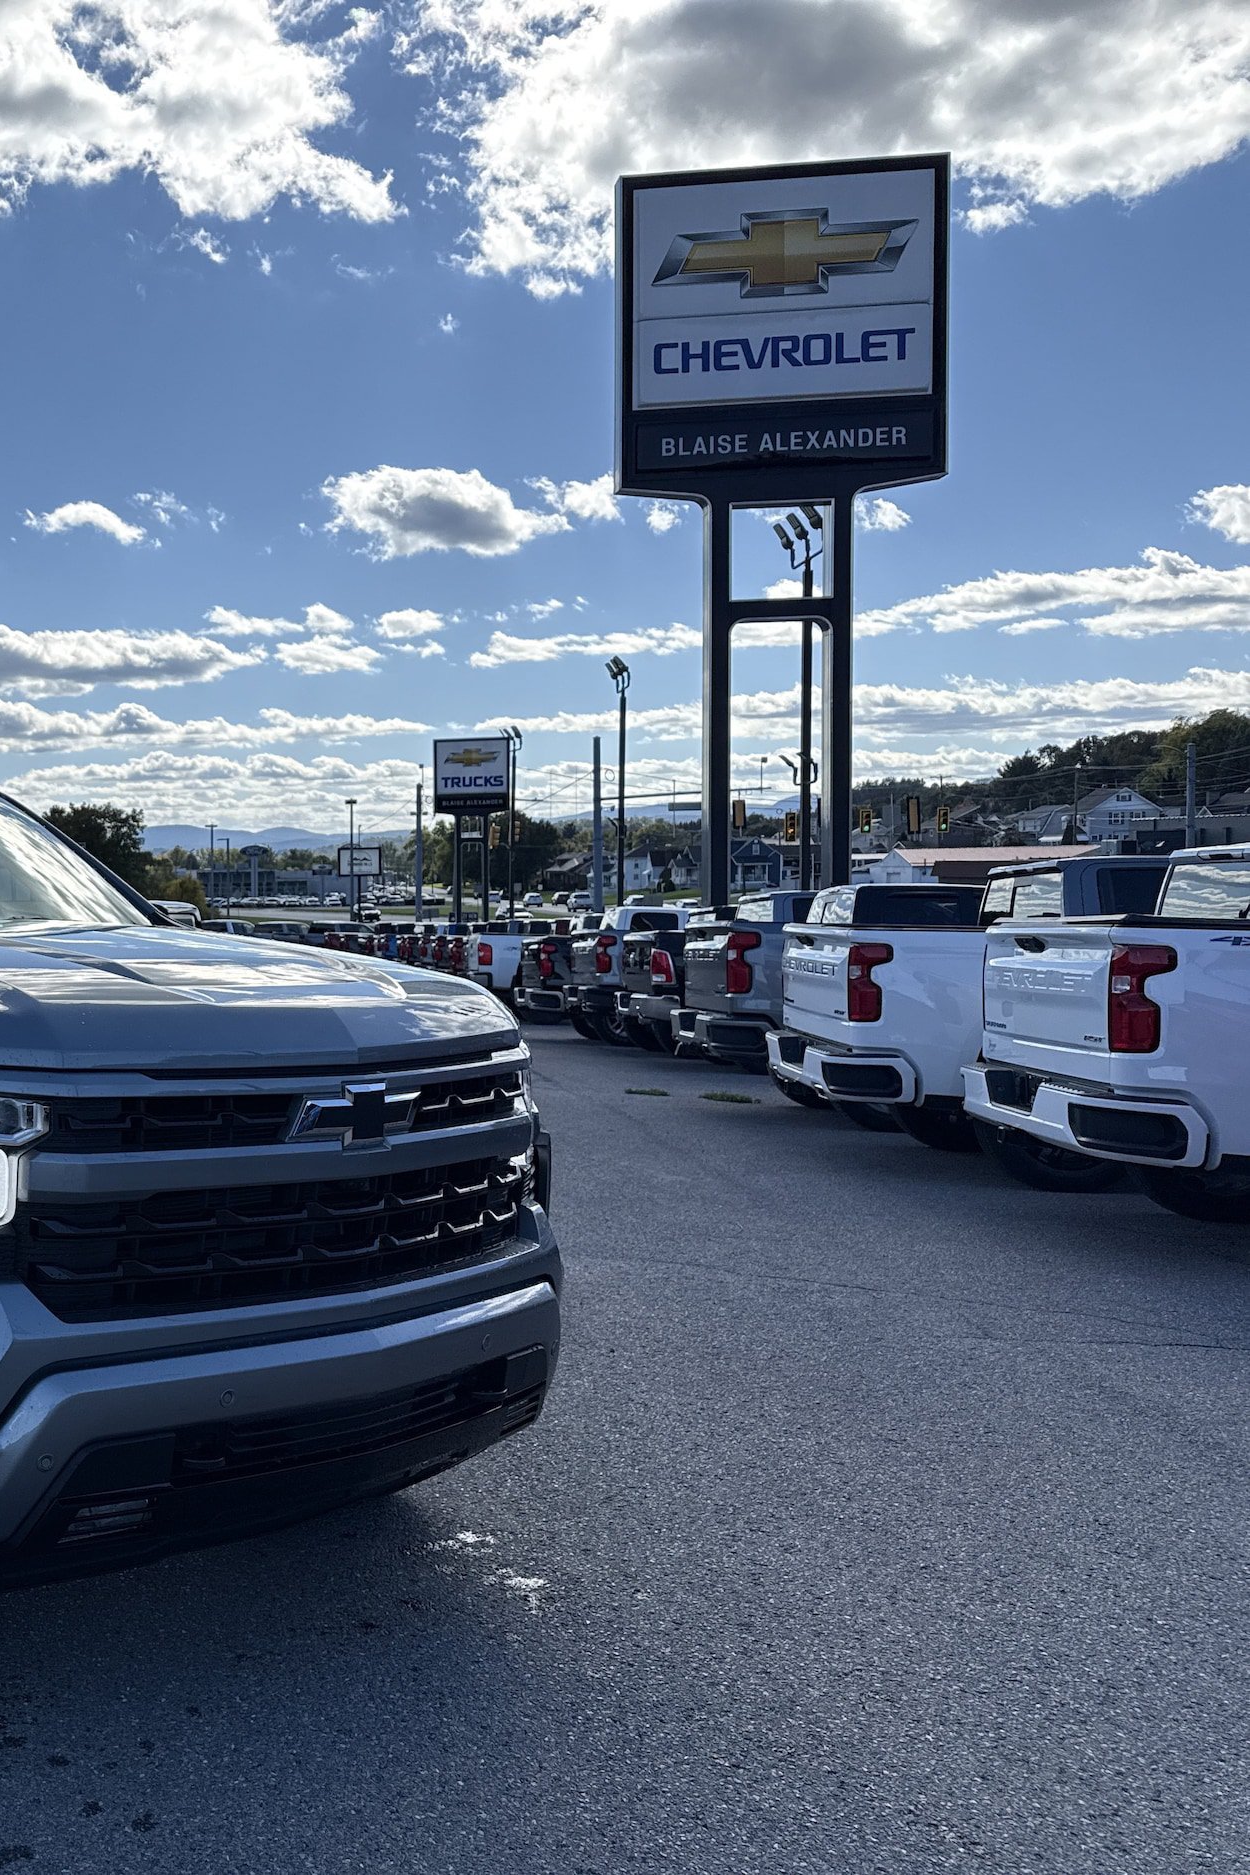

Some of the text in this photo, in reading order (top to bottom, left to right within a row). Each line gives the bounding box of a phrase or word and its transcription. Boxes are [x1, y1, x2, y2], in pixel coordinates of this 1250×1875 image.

[653, 327, 916, 375] CHEVROLET
[661, 426, 907, 458] BLAISE ALEXANDER
[441, 775, 504, 788] TRUCKS
[783, 959, 839, 977] CHEVROLET
